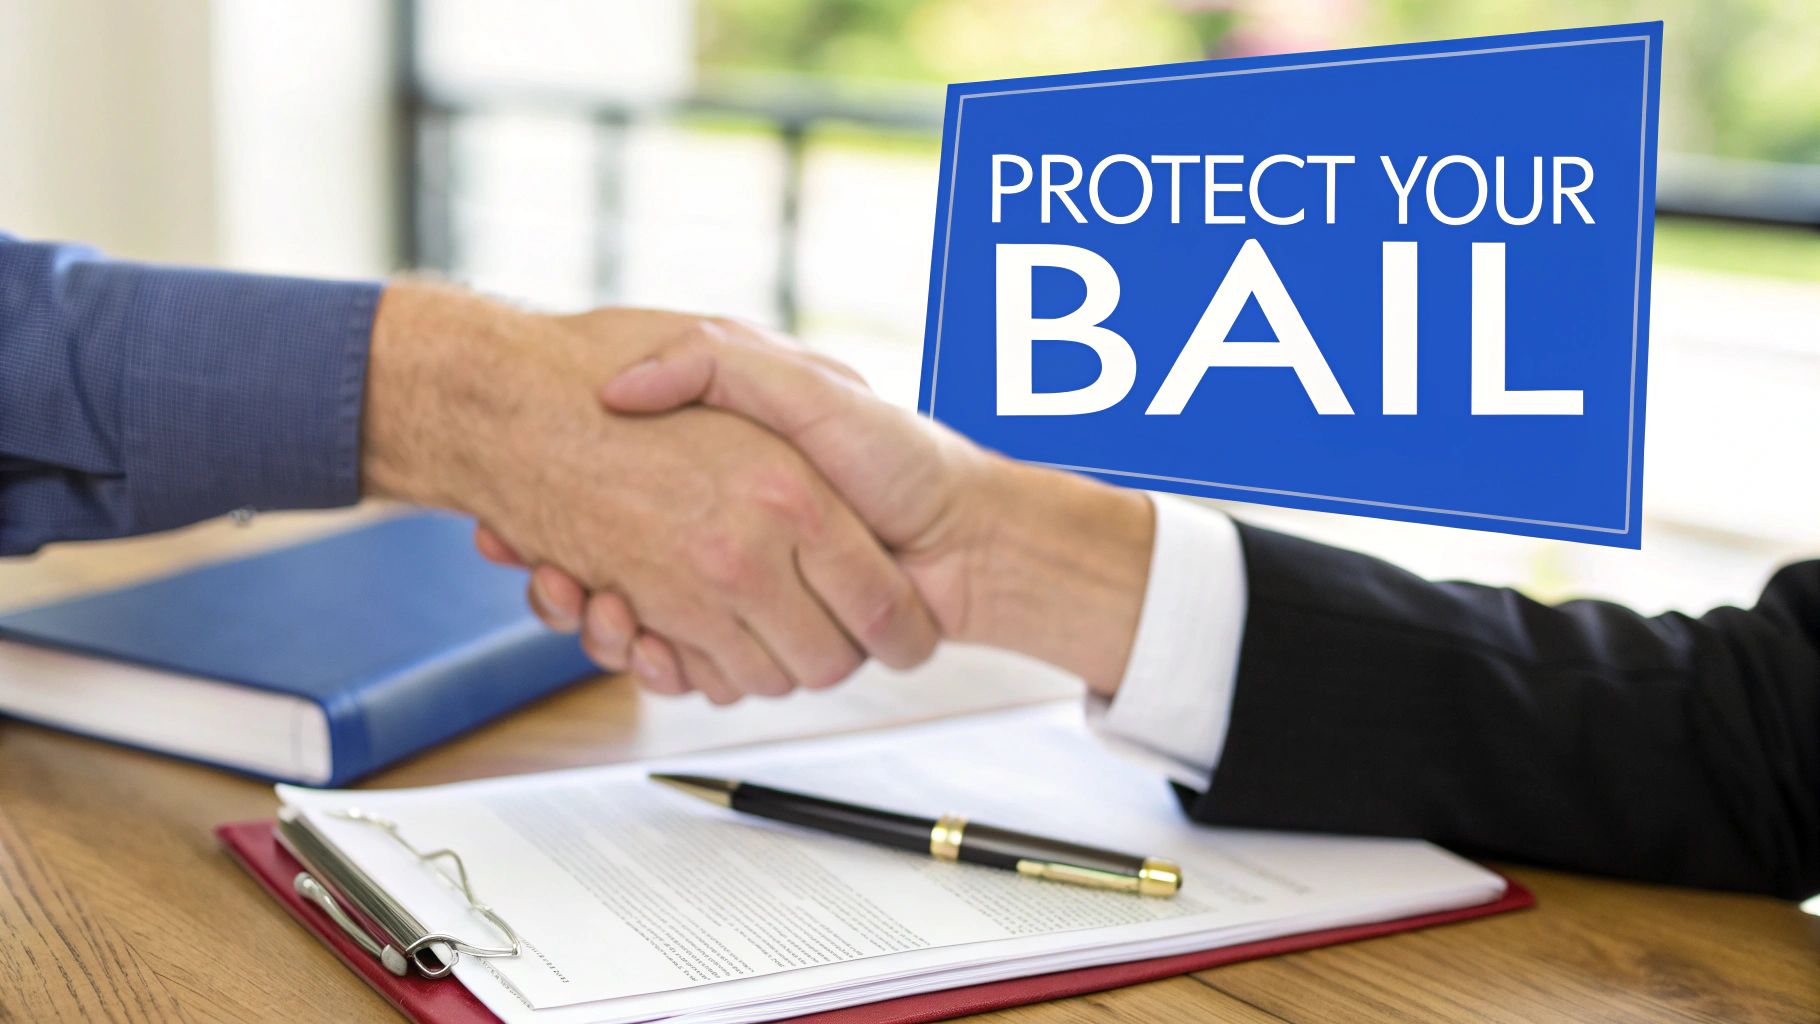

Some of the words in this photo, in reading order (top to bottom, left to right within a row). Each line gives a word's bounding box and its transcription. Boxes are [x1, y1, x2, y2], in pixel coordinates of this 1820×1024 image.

[991, 153, 1356, 226] PROTECT
[1380, 155, 1596, 226] YOUR
[995, 238, 1584, 416] BAIL
